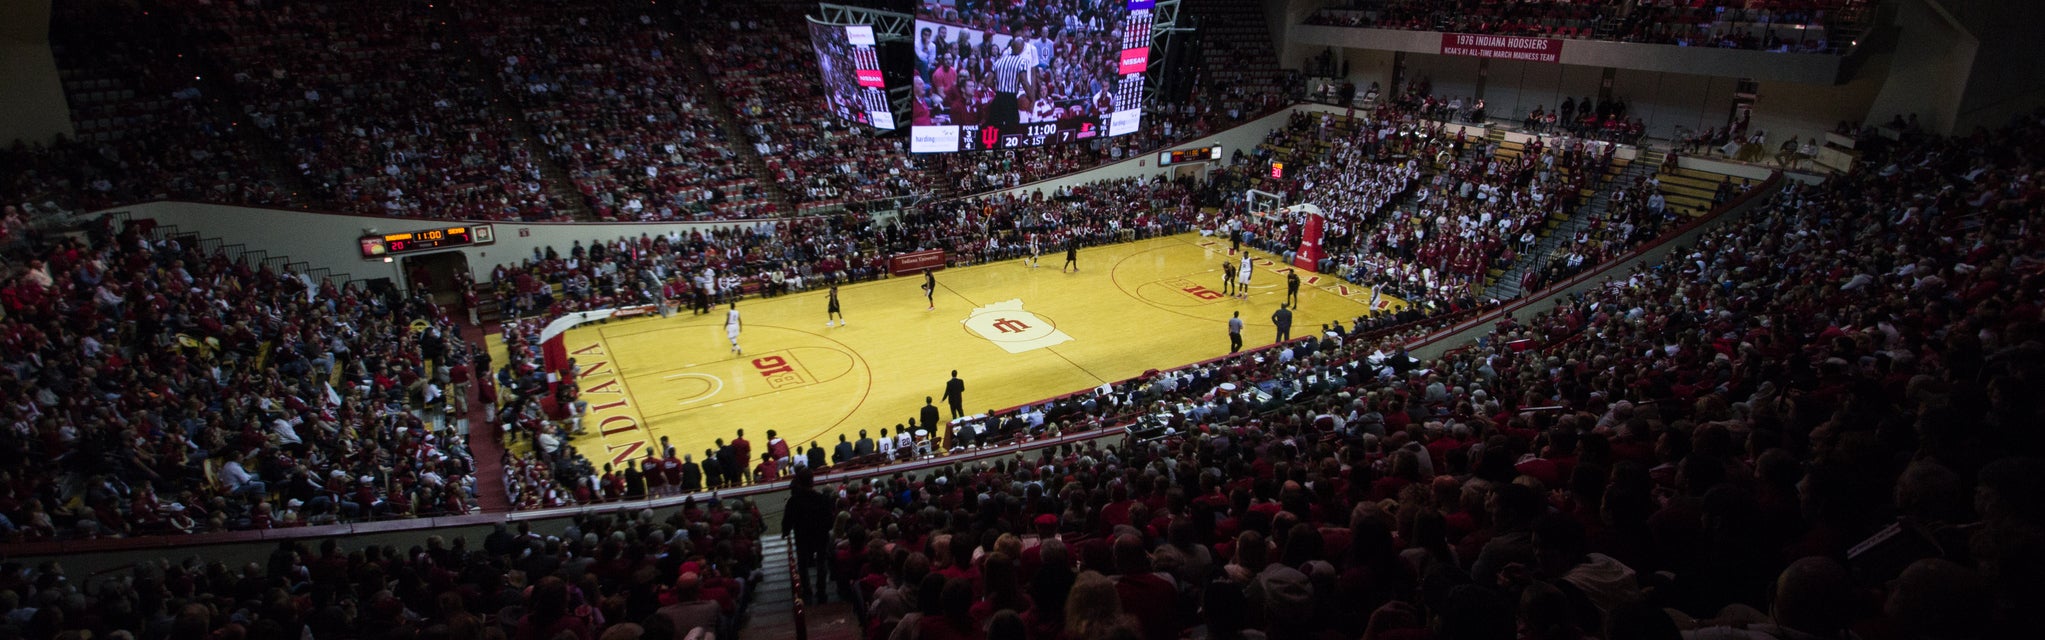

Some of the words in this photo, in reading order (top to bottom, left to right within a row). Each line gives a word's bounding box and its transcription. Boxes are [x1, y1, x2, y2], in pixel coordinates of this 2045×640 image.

[1457, 35, 1474, 46] 1976
[1475, 36, 1506, 48] INDIANA
[1507, 38, 1548, 50] HOOSIERS
[1444, 47, 1461, 55] NCAA'S
[1462, 48, 1468, 56] #1
[1469, 49, 1492, 57] ALL-TIME
[1493, 50, 1512, 59] MARCH
[1512, 51, 1539, 60] MADNESS
[1540, 53, 1555, 62] TEAM
[1123, 57, 1146, 66] NISSAN
[1027, 123, 1057, 136] 11:00
[1005, 137, 1019, 147] 20
[1031, 135, 1046, 146] 1ST
[1062, 131, 1069, 142] 7
[417, 230, 442, 241] 11:00
[391, 241, 404, 251] 20
[902, 437, 911, 446] 20
